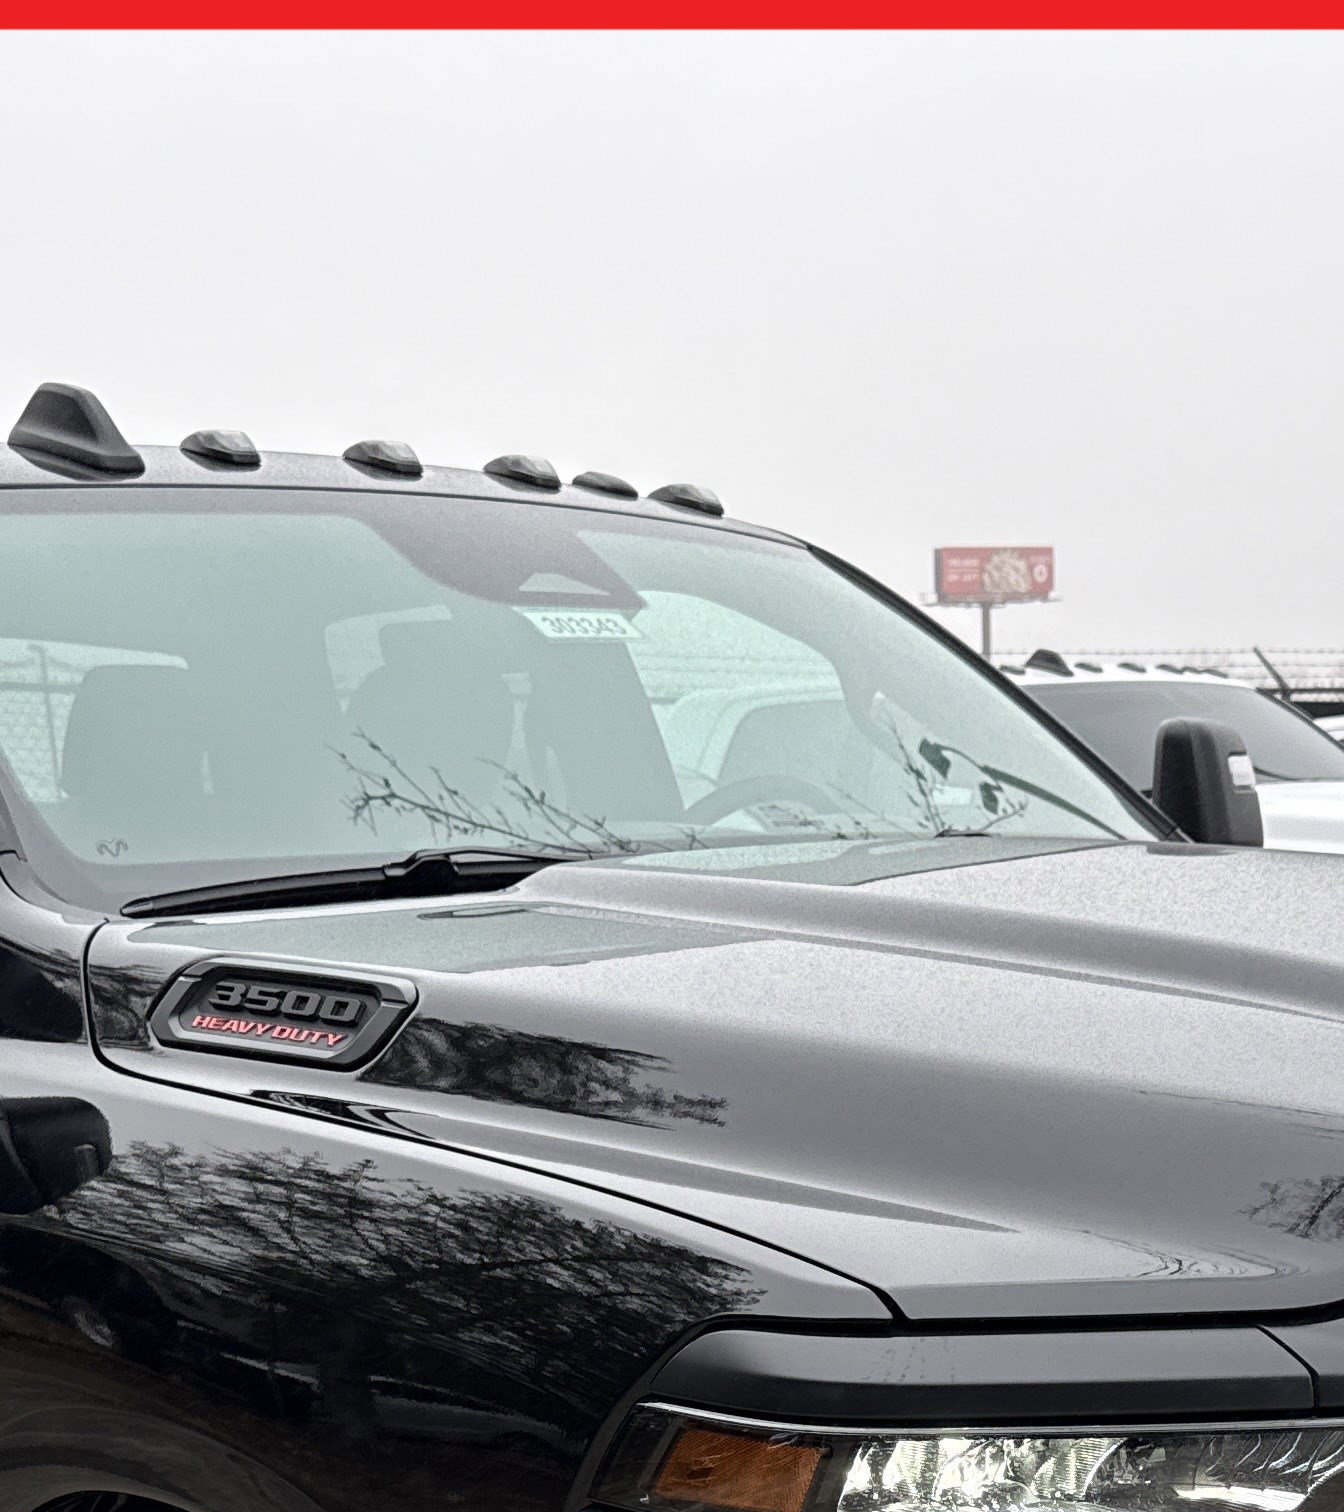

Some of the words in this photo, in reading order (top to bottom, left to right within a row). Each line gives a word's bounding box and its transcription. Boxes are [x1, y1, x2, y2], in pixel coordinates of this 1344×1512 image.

[541, 615, 628, 635] 303343
[208, 980, 364, 1024] 3500
[191, 1014, 270, 1037] HEAVY
[270, 1024, 348, 1048] DUTY
